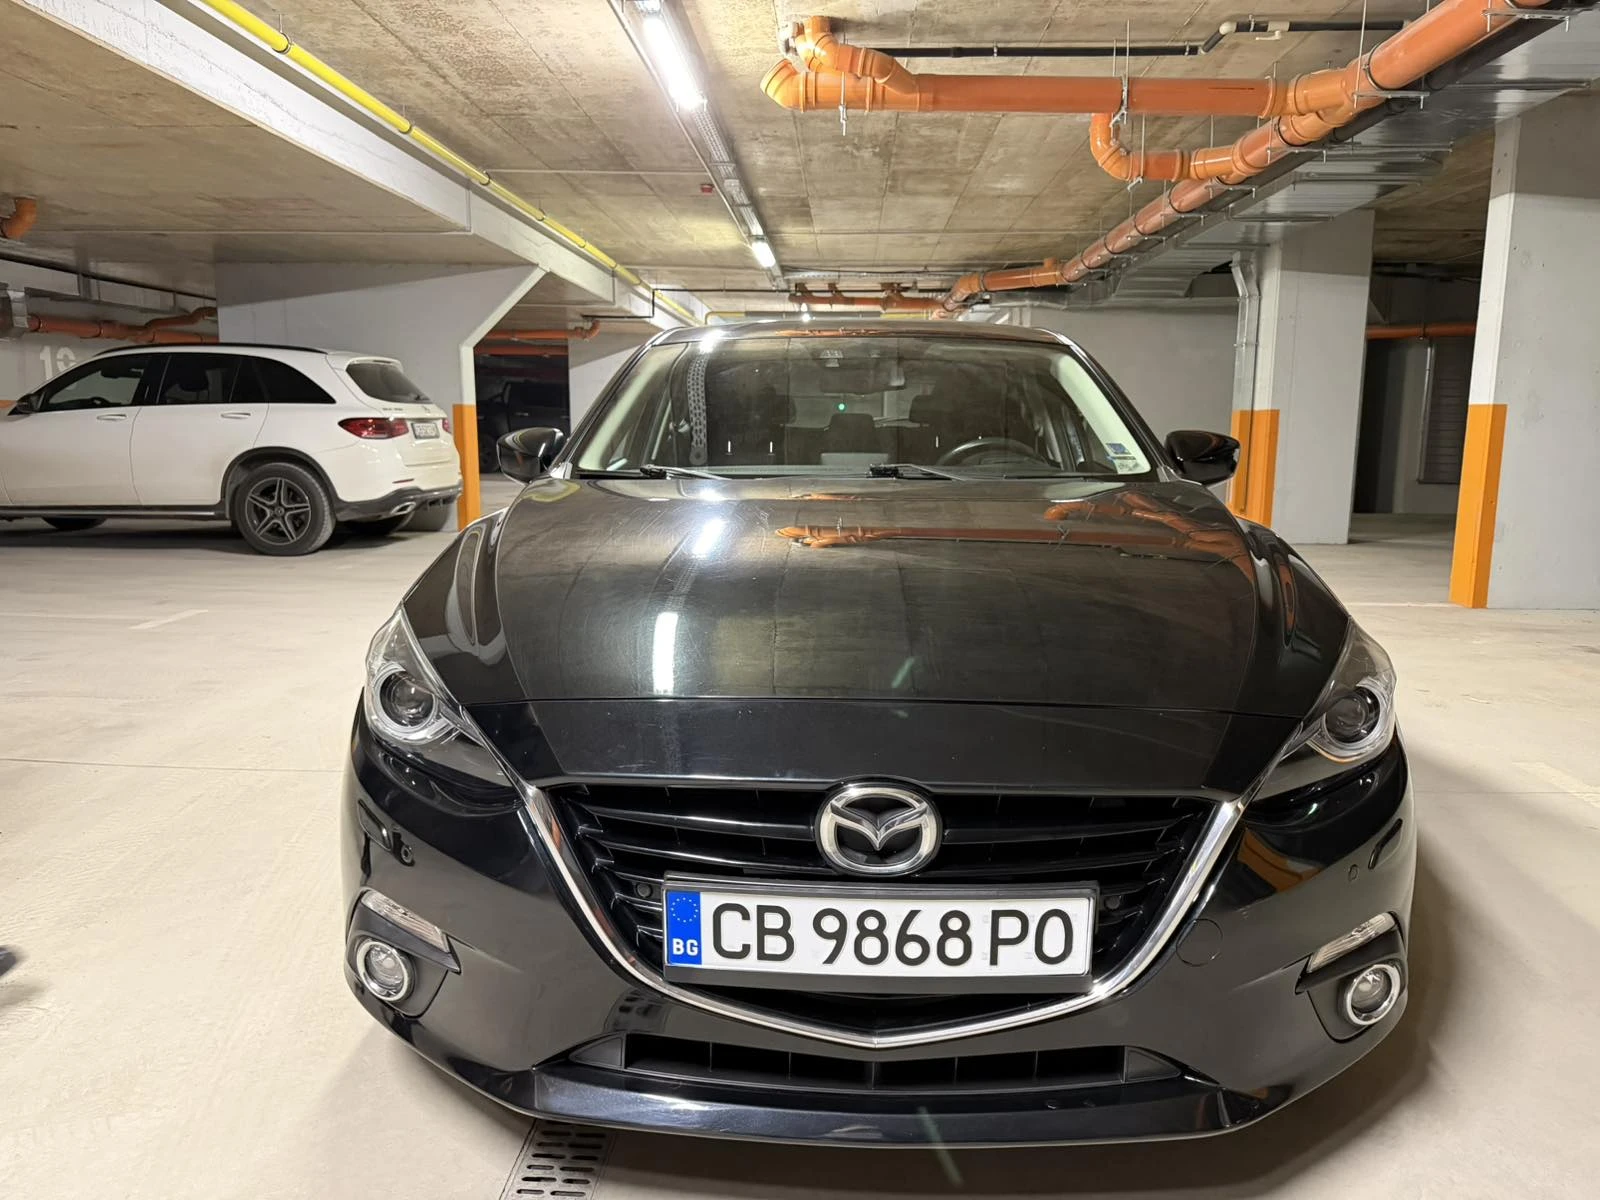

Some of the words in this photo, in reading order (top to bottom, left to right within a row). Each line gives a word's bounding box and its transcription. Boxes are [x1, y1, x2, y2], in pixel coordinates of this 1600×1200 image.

[672, 938, 699, 955] BG
[712, 902, 795, 962] CB
[812, 907, 973, 967] 9868
